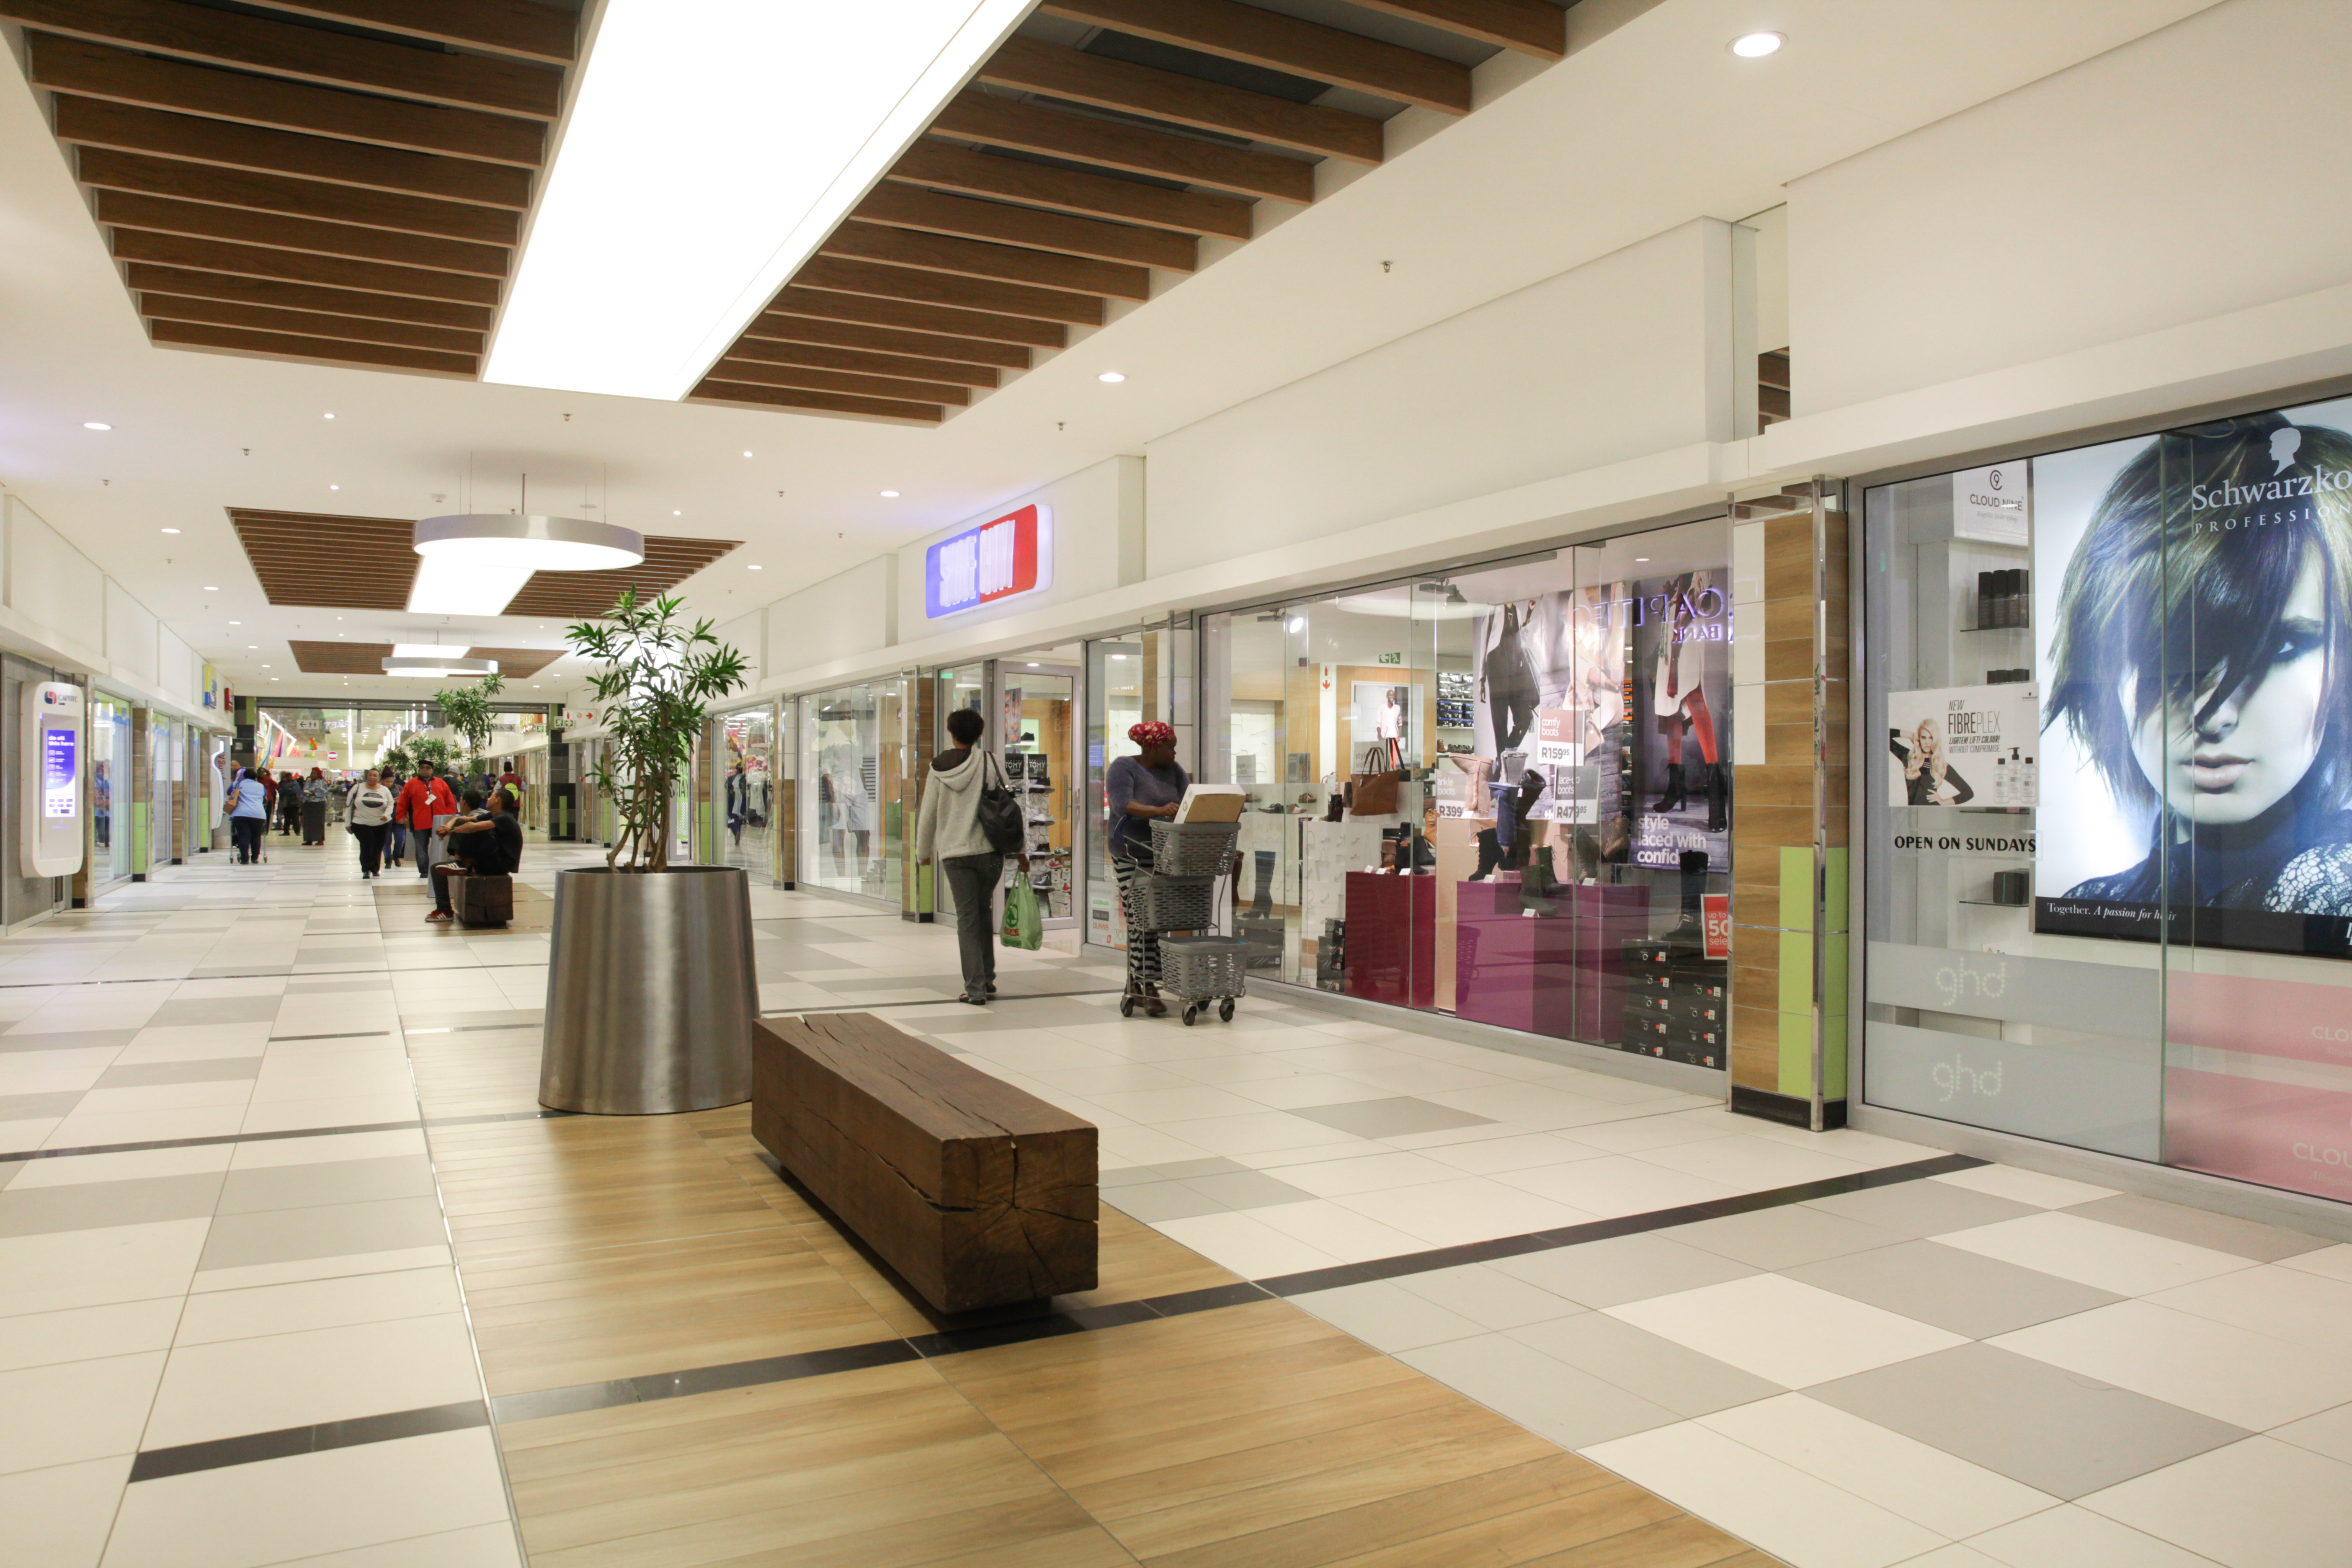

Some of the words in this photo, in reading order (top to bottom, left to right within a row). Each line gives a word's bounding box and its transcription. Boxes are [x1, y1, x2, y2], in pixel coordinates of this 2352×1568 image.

[2192, 464, 2352, 511] Schwarzko
[1970, 494, 2000, 507] CLOUD
[2003, 498, 2022, 511] NINE
[2195, 504, 2351, 534] PROFESSION
[1948, 700, 1965, 711] NEW
[1542, 717, 1560, 728] comfy
[1948, 711, 2001, 734] FIBREPLEX
[1542, 727, 1559, 736] boots
[1981, 735, 2001, 743] COLOUR!
[1355, 752, 1366, 760] styl
[1949, 745, 1968, 753] WITHOUT
[1437, 777, 1453, 786] ankle
[1558, 785, 1574, 794] boots
[1437, 786, 1456, 795] boots
[1638, 815, 1669, 832] style
[1638, 830, 1673, 847] laced
[1677, 832, 1707, 848] with
[1895, 836, 1932, 849] OPEN
[1939, 837, 1960, 850] ON
[1966, 837, 2036, 852] SUNDAYS
[2047, 903, 2091, 916] Together.
[2094, 906, 2101, 915] A
[2103, 907, 2135, 918] passion
[2136, 908, 2152, 921] for
[1093, 922, 1109, 931] DUNNS
[1709, 919, 1728, 936] 50
[1709, 936, 1728, 945] sele
[1936, 957, 2006, 1007] ghd
[2312, 1026, 2352, 1042] CLO
[1932, 1053, 2002, 1103] ghd
